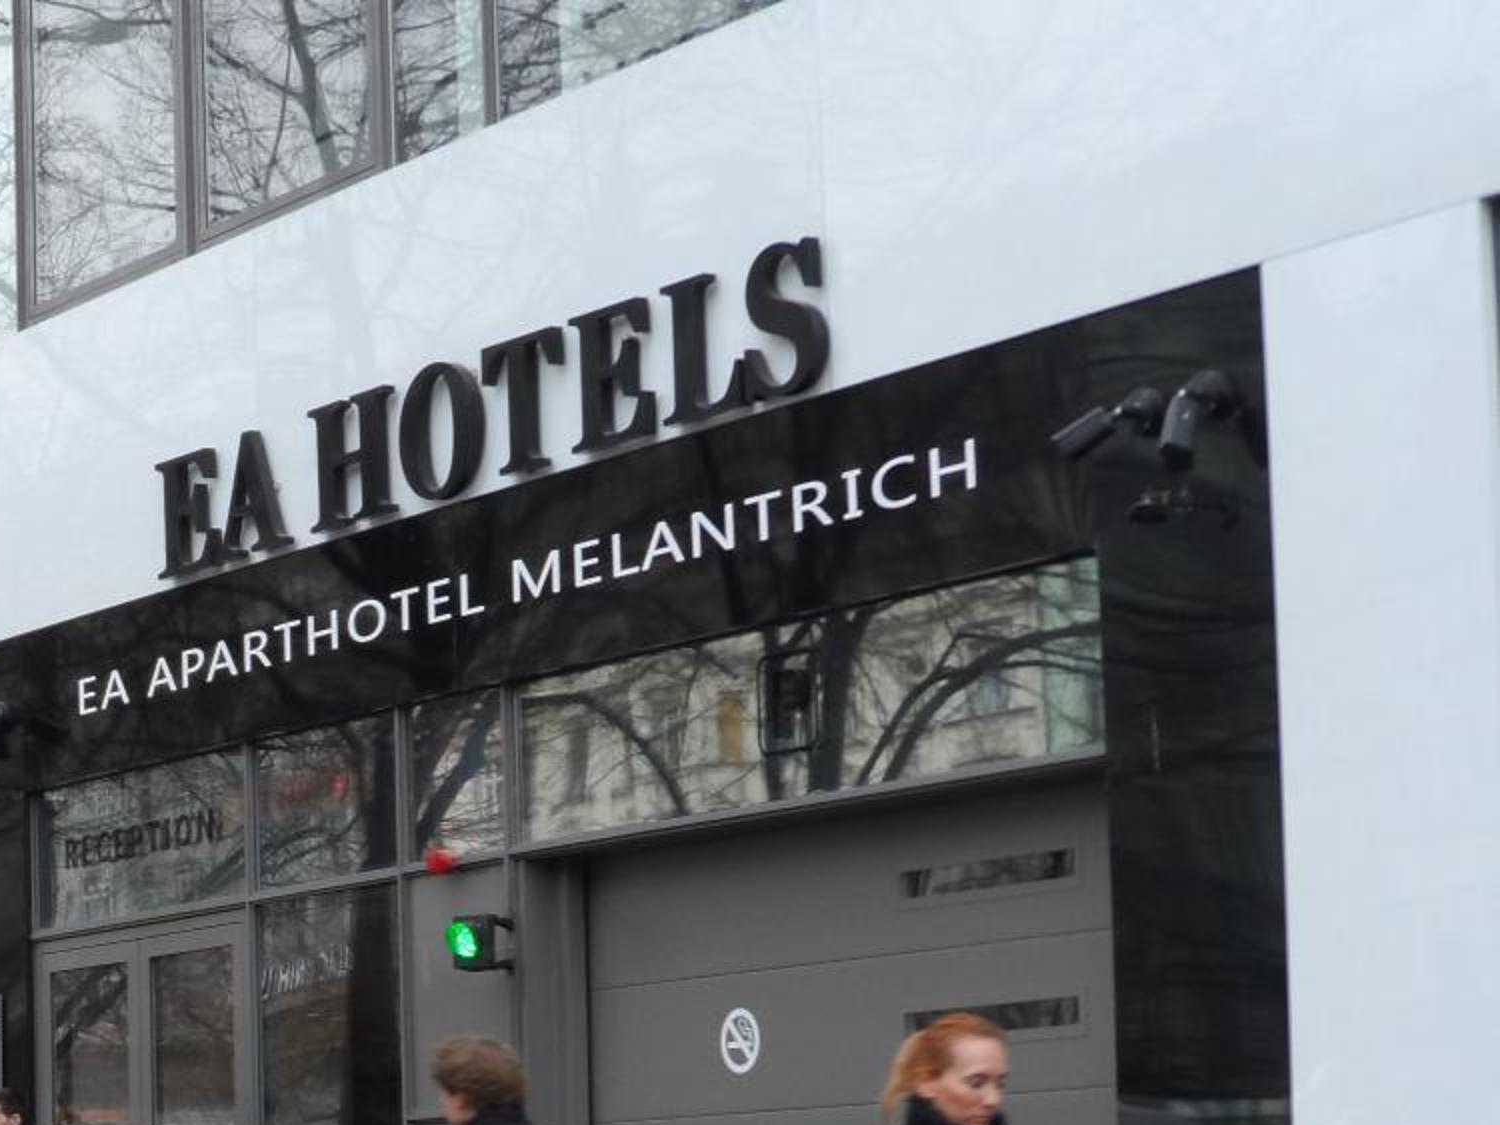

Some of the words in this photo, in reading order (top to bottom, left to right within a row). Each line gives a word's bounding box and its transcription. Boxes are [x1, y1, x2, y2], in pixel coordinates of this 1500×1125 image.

[155, 431, 295, 581] EA
[308, 237, 831, 534] HOTELS
[77, 670, 131, 716] EA
[147, 574, 485, 699] APARTHOTEL
[511, 438, 978, 604] MELANTRICH
[66, 808, 216, 869] RECEPTION
